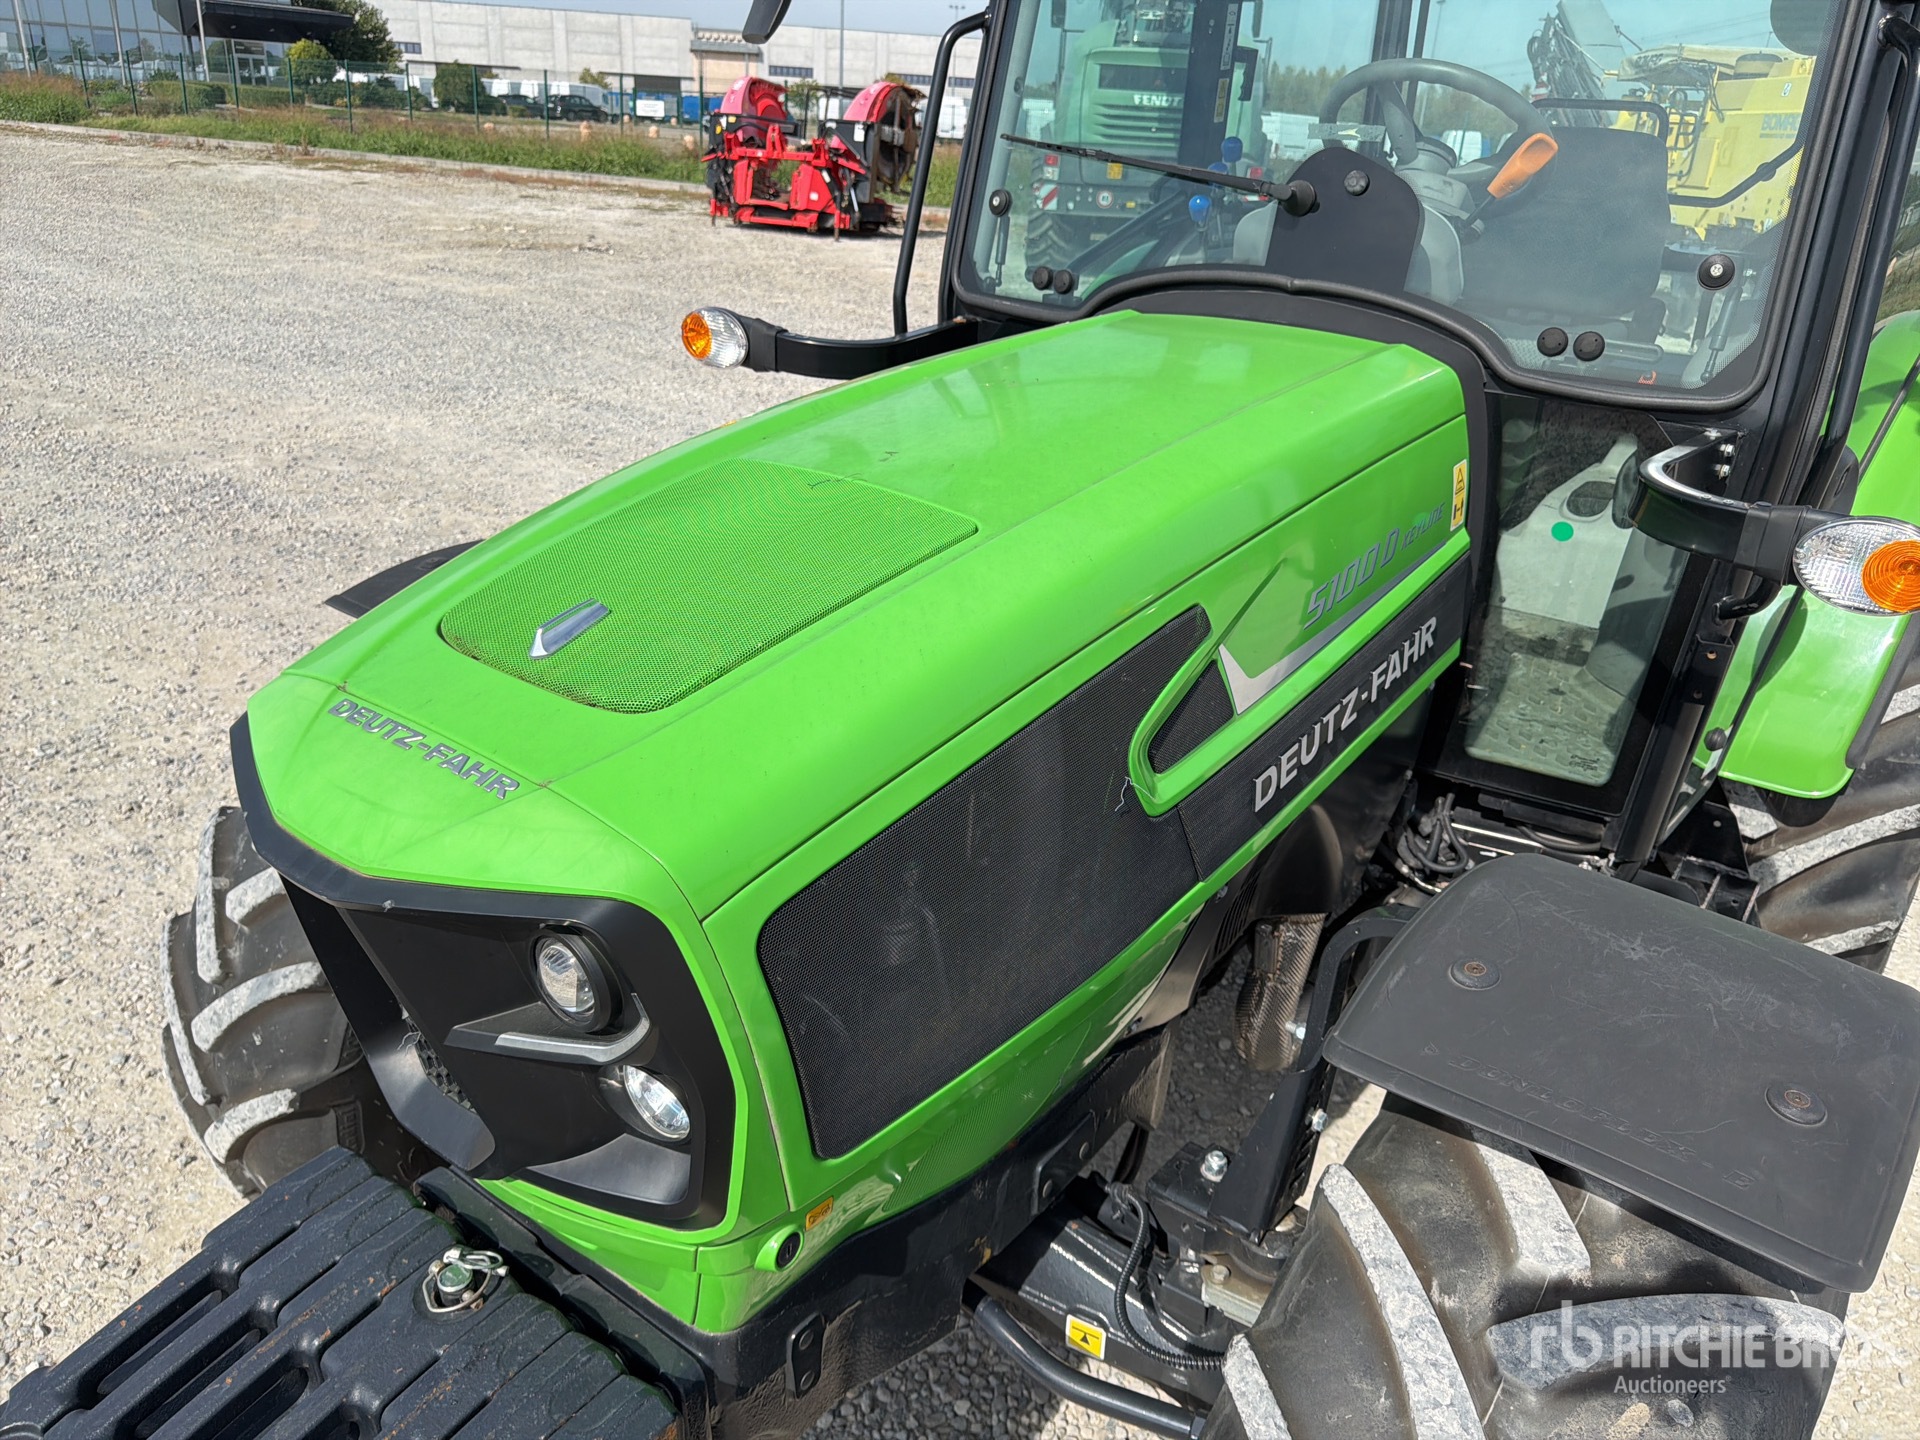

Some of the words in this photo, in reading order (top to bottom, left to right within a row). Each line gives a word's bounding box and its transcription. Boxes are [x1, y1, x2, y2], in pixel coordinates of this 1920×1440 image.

[1133, 94, 1182, 107] FENDT
[1303, 543, 1380, 630] 5100
[328, 698, 520, 800] DEUTZ-FAHR
[1253, 616, 1437, 813] DEUTZ-FAHR
